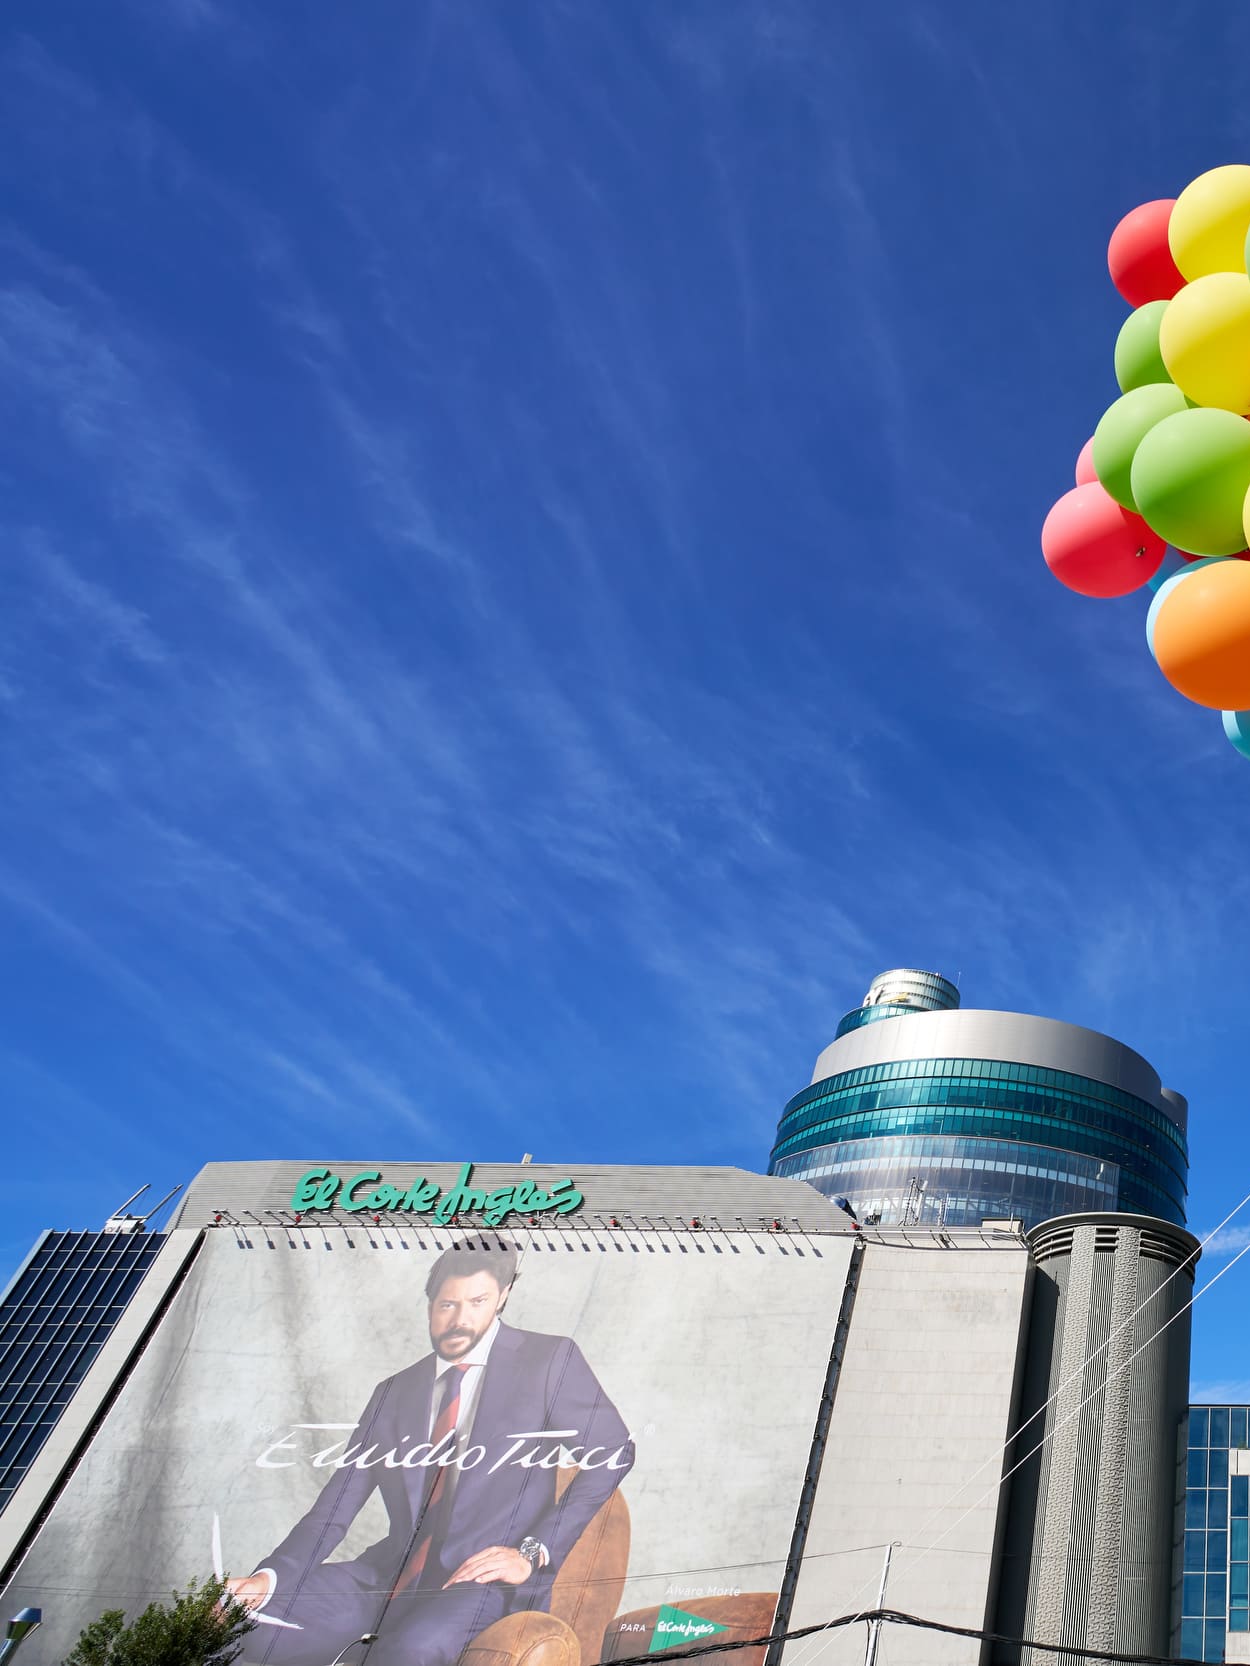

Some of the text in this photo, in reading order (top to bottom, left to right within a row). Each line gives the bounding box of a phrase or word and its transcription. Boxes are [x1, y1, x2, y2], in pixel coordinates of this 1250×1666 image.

[291, 1162, 583, 1226] El Corte Inglés
[256, 1423, 637, 1475] Emidio Tucci
[707, 1585, 741, 1597] Morte
[620, 1623, 646, 1632] PARA
